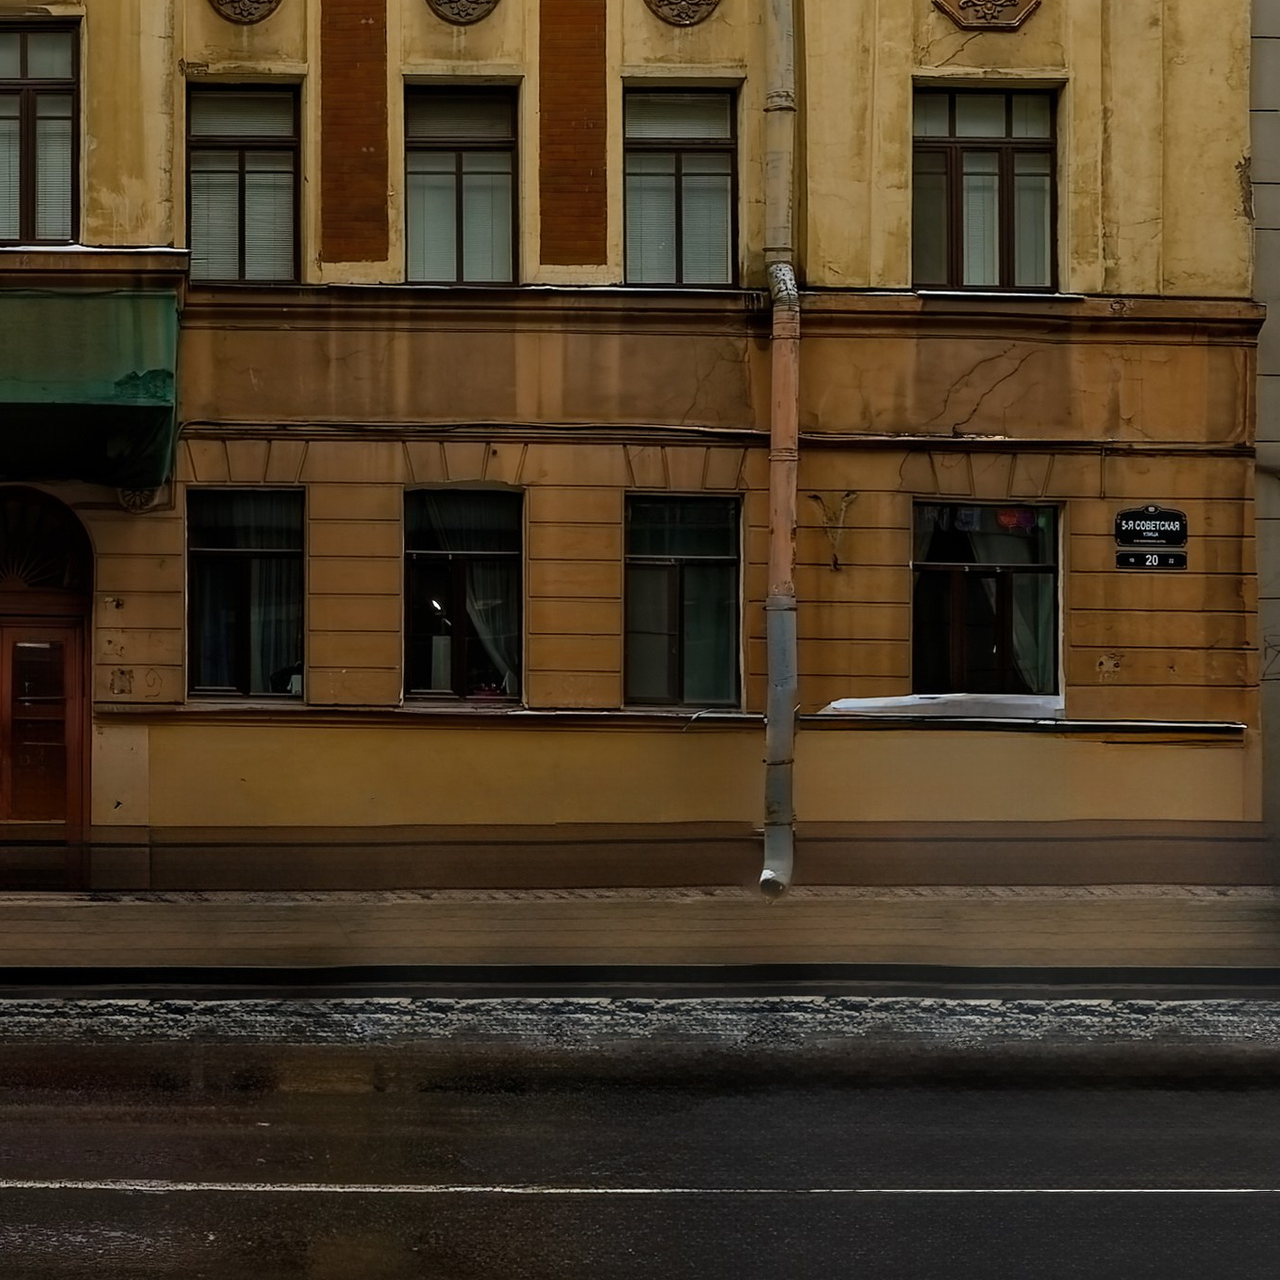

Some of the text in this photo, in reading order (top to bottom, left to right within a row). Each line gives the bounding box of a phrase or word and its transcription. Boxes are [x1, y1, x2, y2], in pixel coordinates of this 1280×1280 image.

[1121, 520, 1180, 531] 5-Я СОВЕТСКАЯ
[1145, 554, 1159, 566] 20
